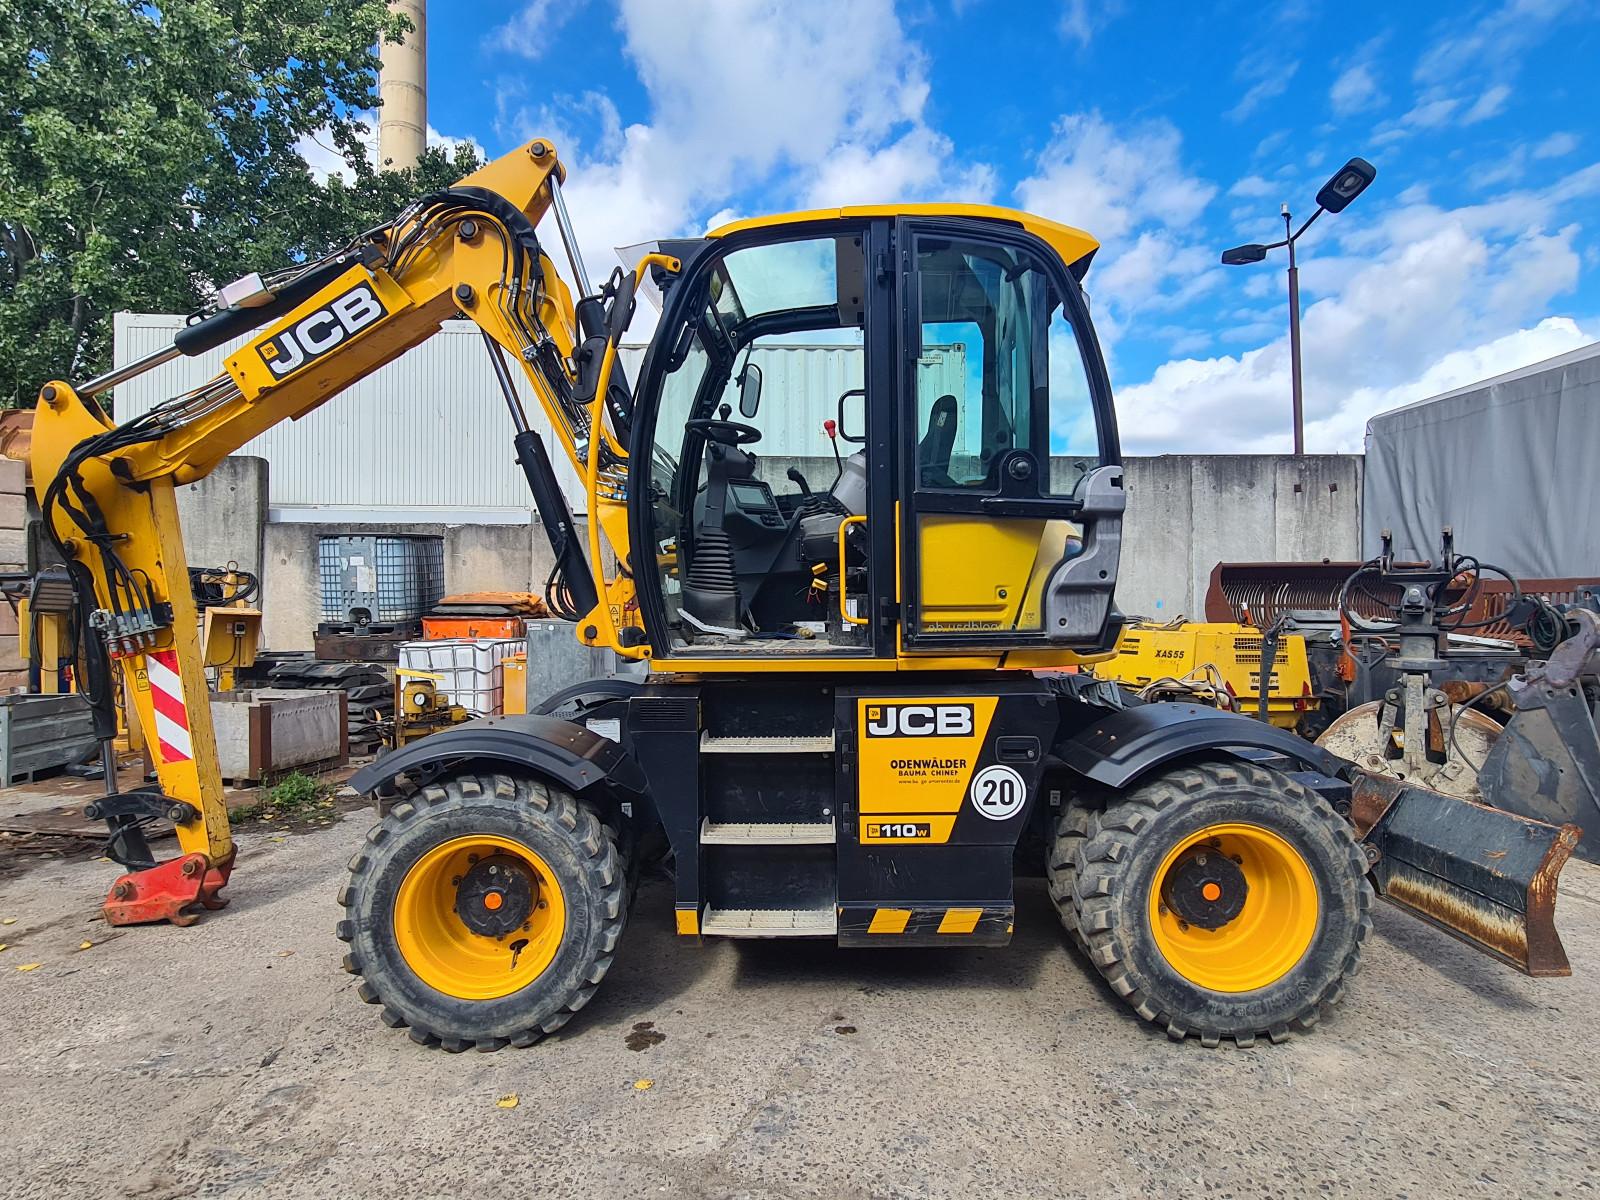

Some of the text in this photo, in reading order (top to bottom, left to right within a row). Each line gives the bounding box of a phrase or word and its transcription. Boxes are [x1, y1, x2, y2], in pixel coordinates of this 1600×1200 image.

[269, 287, 382, 374] JCB
[1154, 649, 1185, 659] XAS55
[868, 706, 972, 736] JCB
[982, 779, 1015, 806] 20
